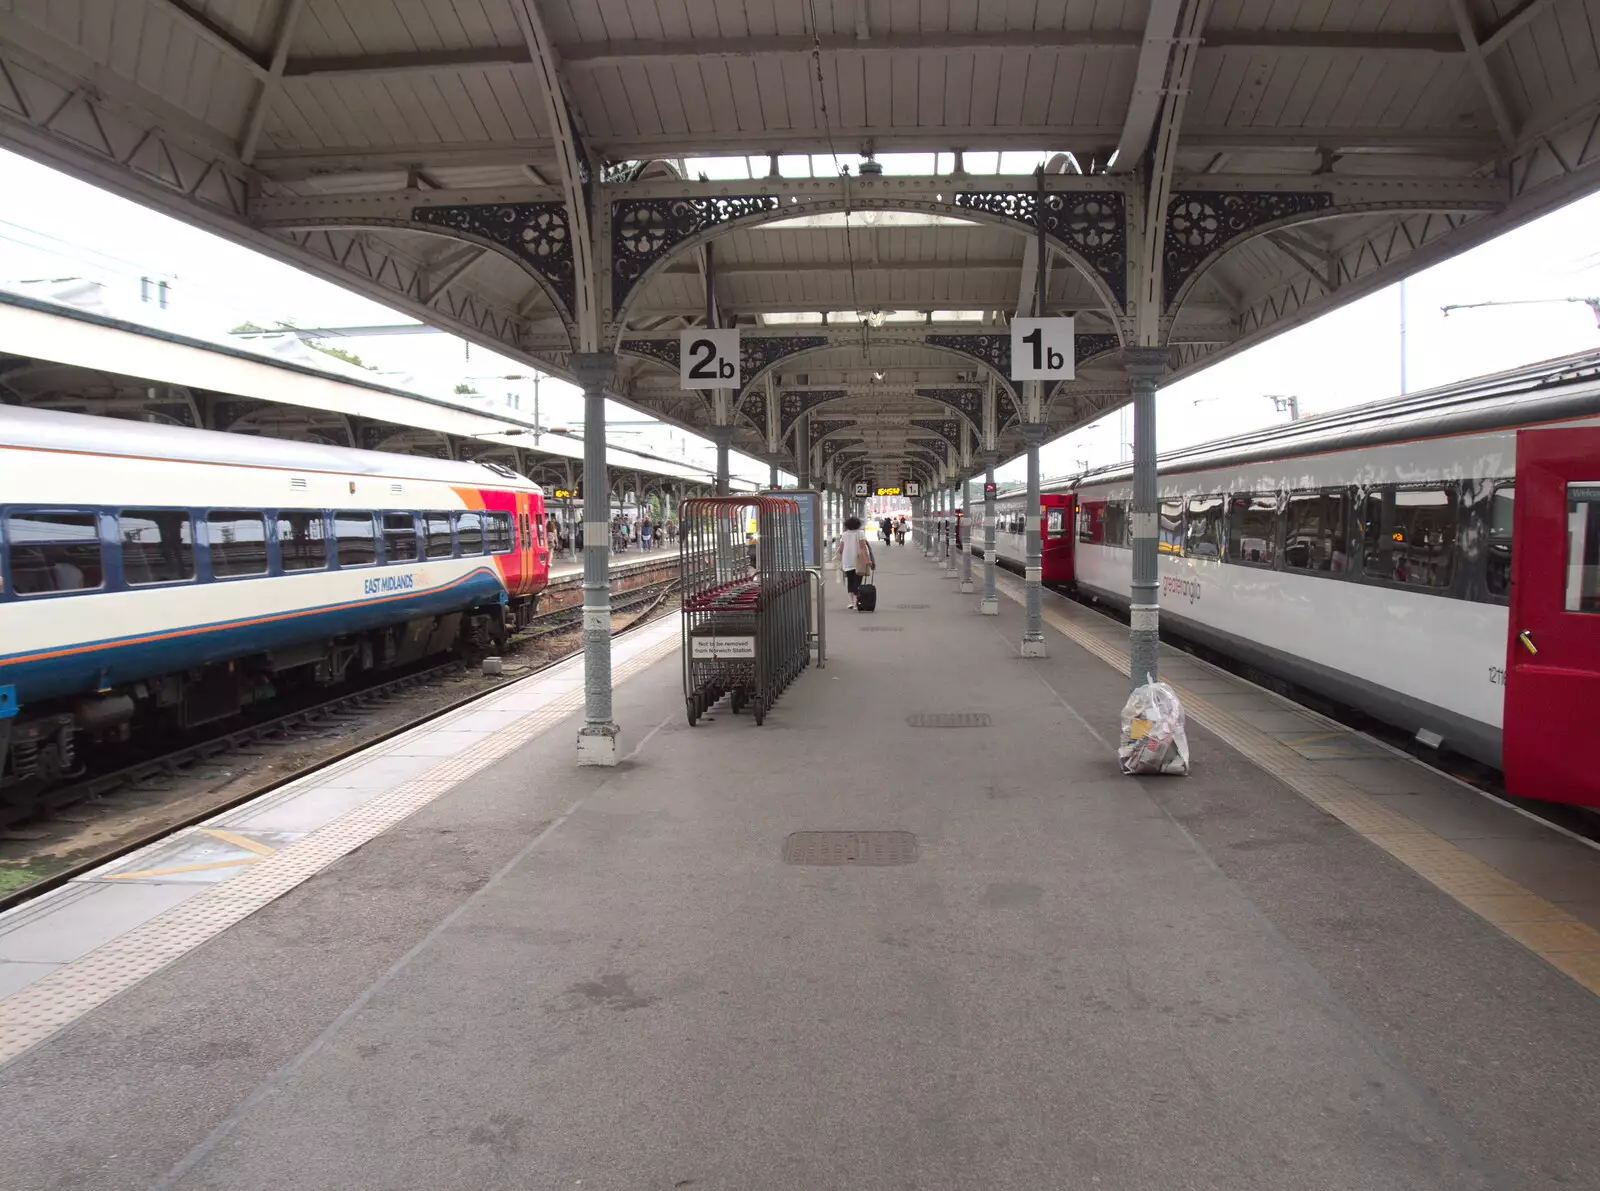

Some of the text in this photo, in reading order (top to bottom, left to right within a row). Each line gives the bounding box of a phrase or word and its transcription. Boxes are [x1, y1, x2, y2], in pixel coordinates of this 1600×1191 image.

[688, 338, 735, 379] 2b
[1022, 327, 1064, 370] 1b
[364, 577, 380, 595] EAST
[381, 573, 414, 593] MIDLANDS
